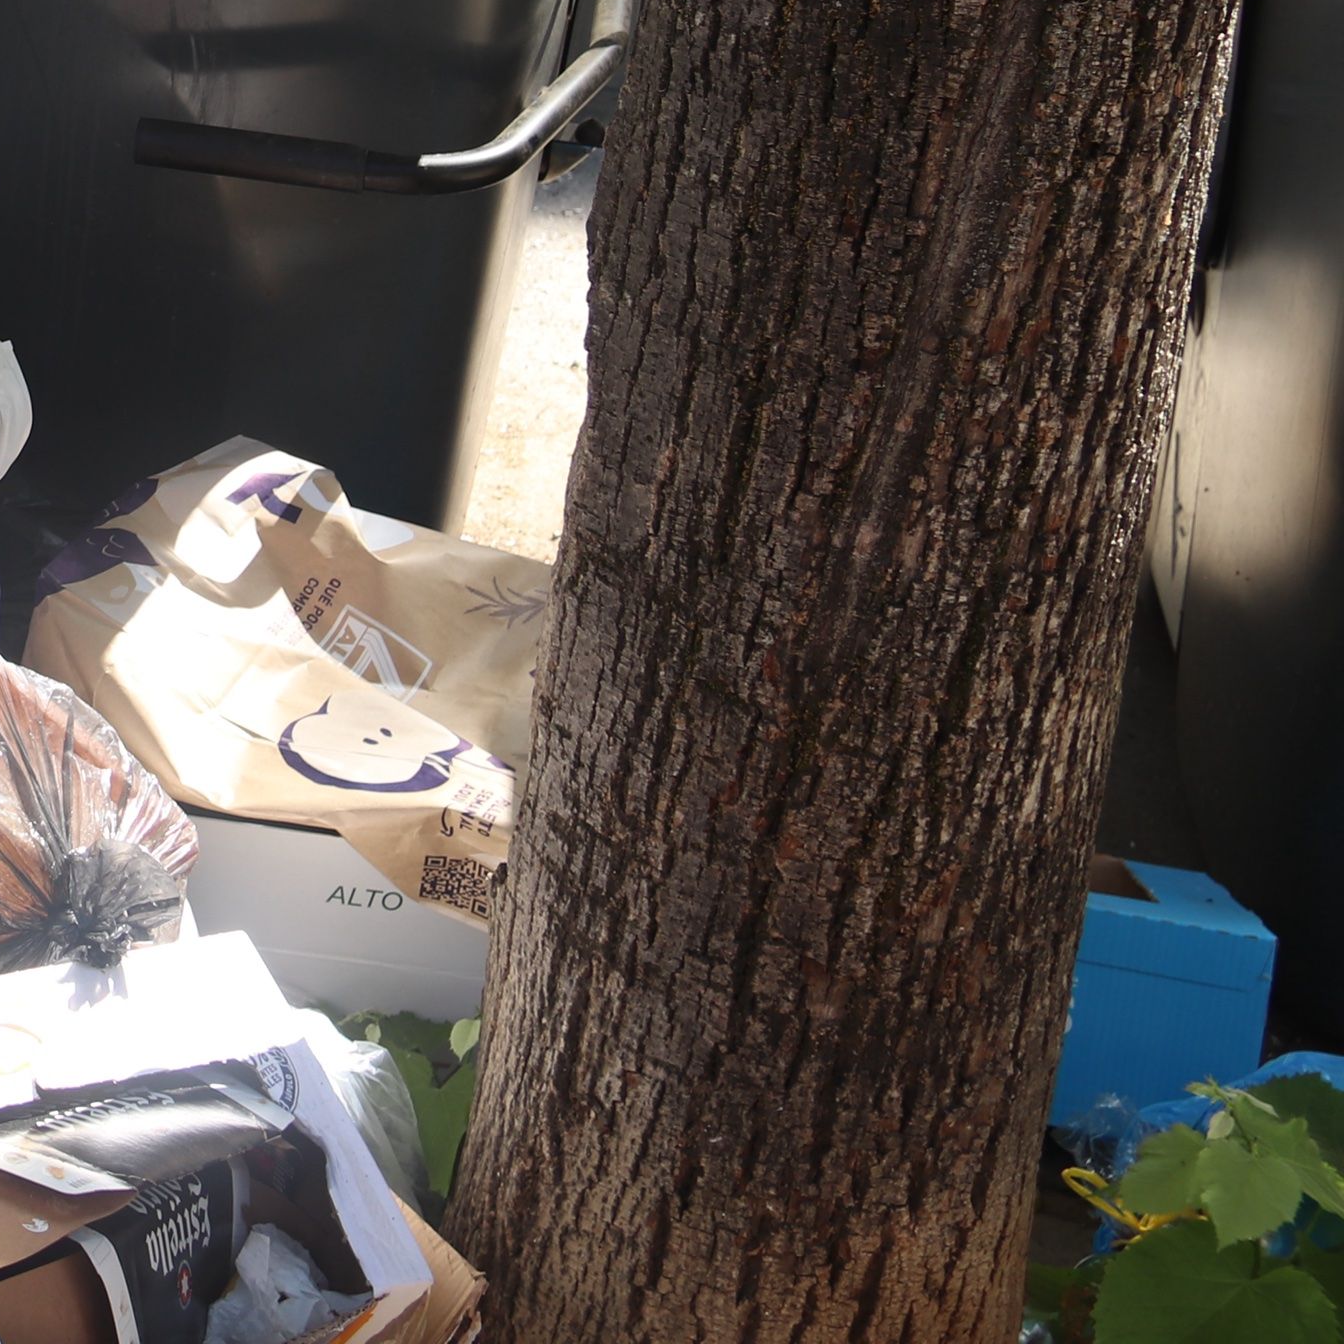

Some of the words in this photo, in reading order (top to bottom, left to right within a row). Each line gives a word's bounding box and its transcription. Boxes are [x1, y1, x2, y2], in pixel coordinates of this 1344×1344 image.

[318, 577, 341, 608] QUÉ
[326, 885, 403, 911] ALTO
[145, 1194, 211, 1277] Estrella
